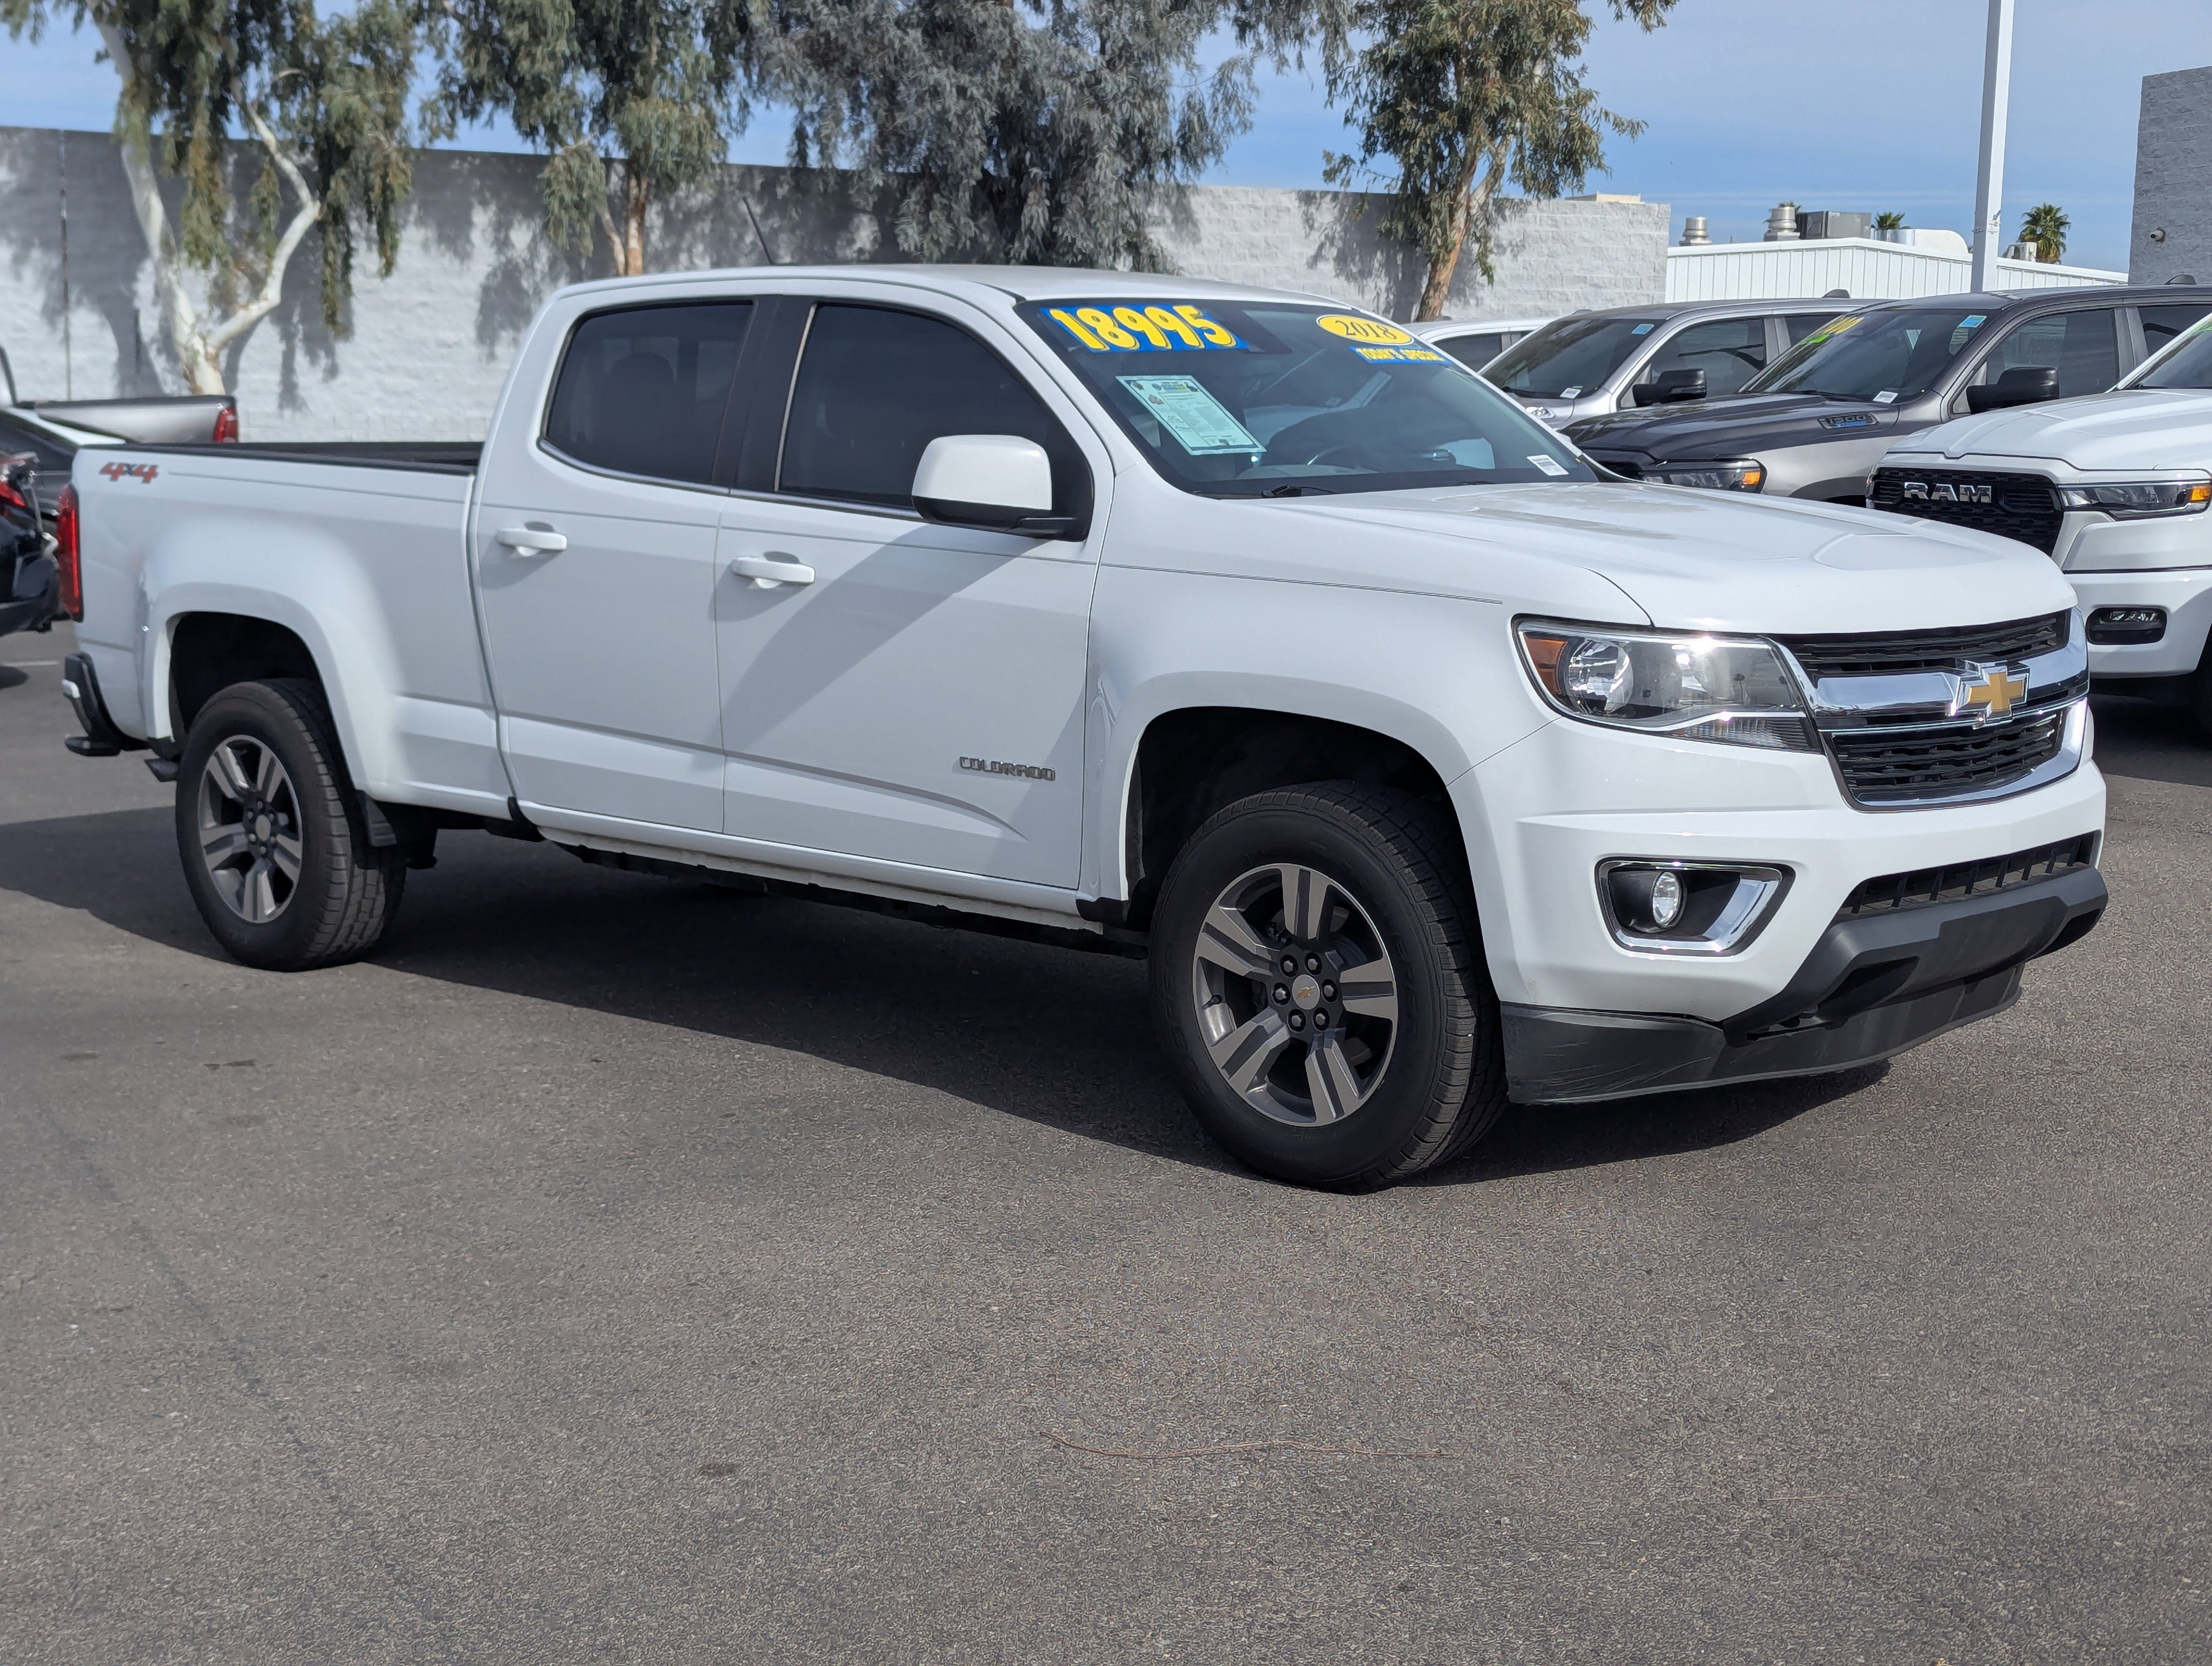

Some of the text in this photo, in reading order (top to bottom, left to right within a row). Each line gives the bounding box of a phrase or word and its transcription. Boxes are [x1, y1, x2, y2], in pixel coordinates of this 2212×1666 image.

[1050, 305, 1237, 350] 18995
[1335, 321, 1398, 340] 2018
[1904, 482, 1992, 503] RAM
[959, 757, 1056, 781] COLORADO
